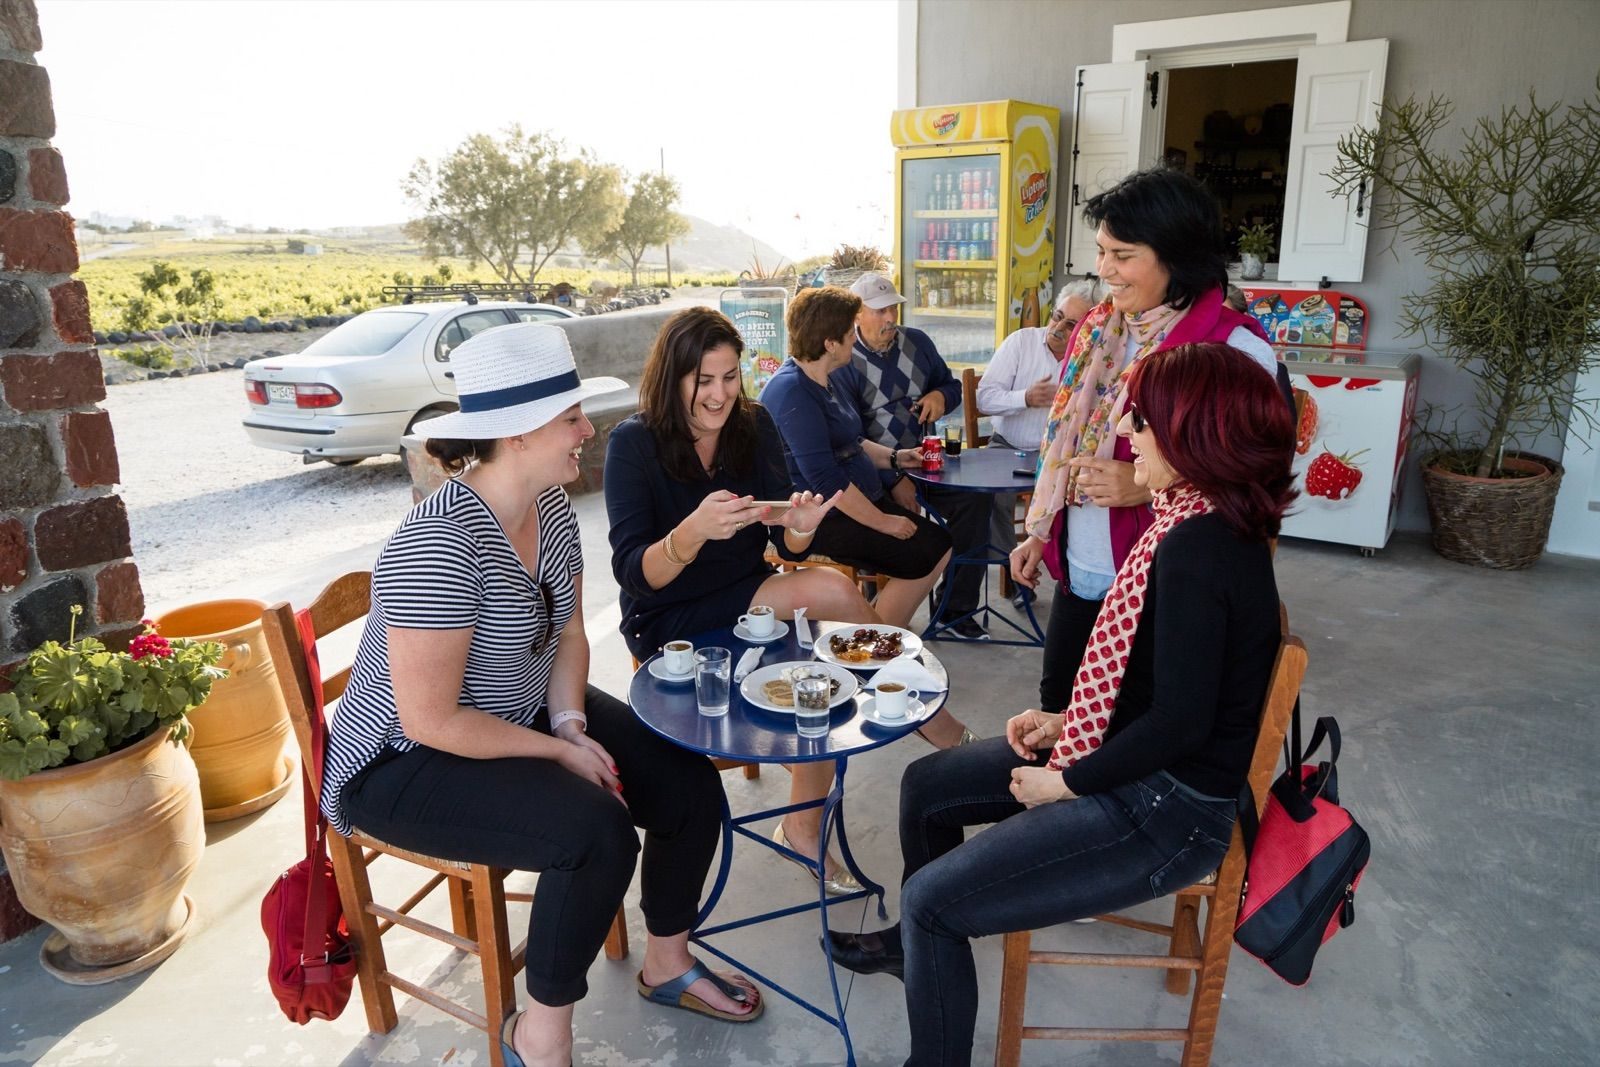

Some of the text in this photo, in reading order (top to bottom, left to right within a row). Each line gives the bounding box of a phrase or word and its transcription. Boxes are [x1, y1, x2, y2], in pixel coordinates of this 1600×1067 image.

[934, 116, 954, 126] Lipton
[1022, 180, 1045, 201] Lipton
[747, 322, 775, 330] ΒΡΕΙΤΕ
